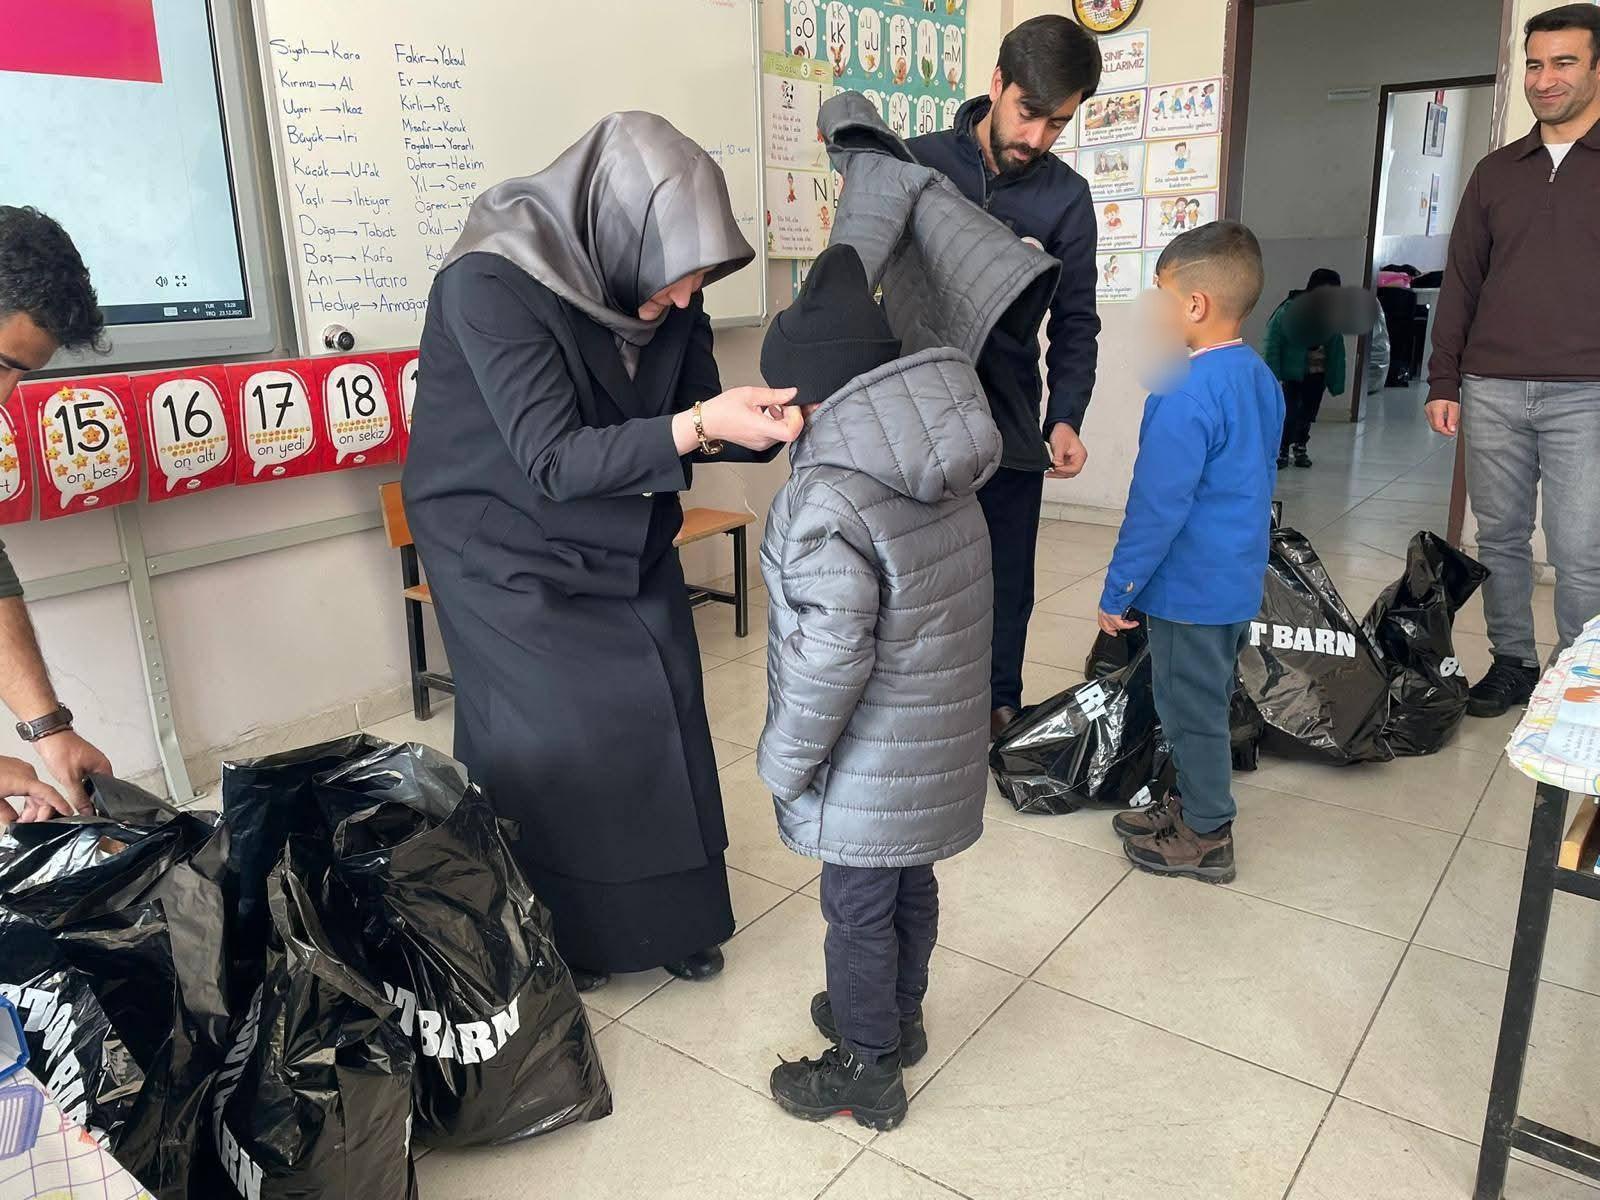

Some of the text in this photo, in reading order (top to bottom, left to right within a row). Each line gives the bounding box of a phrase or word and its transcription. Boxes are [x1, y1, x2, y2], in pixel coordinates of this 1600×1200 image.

[269, 39, 361, 62] Siyah Kara
[394, 43, 426, 63] Fakir
[1104, 50, 1124, 61] SINIF
[279, 69, 354, 91] Kırmızı Al
[398, 71, 462, 89] Ev Konut
[803, 64, 809, 76] 3
[400, 94, 451, 113] Kirli Pis
[442, 120, 467, 133] Konuk
[287, 125, 324, 151] Büyük
[292, 157, 380, 178] Küçük Ufak
[406, 155, 485, 171] Doktor Hekim
[446, 174, 478, 192] Sene
[814, 178, 828, 201] N
[295, 183, 325, 208] Yaşlı
[298, 214, 336, 241] Doğa
[418, 218, 444, 235] Okul
[303, 243, 393, 265] Baş Kafa
[307, 269, 334, 287] Anı
[363, 267, 408, 288] Hatıra
[308, 291, 361, 320] Hediye
[252, 382, 294, 430] 17
[336, 374, 376, 420] 18
[162, 390, 213, 442] 16
[54, 400, 110, 456] 15
[338, 427, 385, 445] on sekiz
[174, 447, 216, 469] on altı
[257, 436, 305, 459] on yedi
[66, 463, 118, 485] on beş
[1272, 623, 1356, 658] BARN
[418, 992, 521, 1065] BARN
